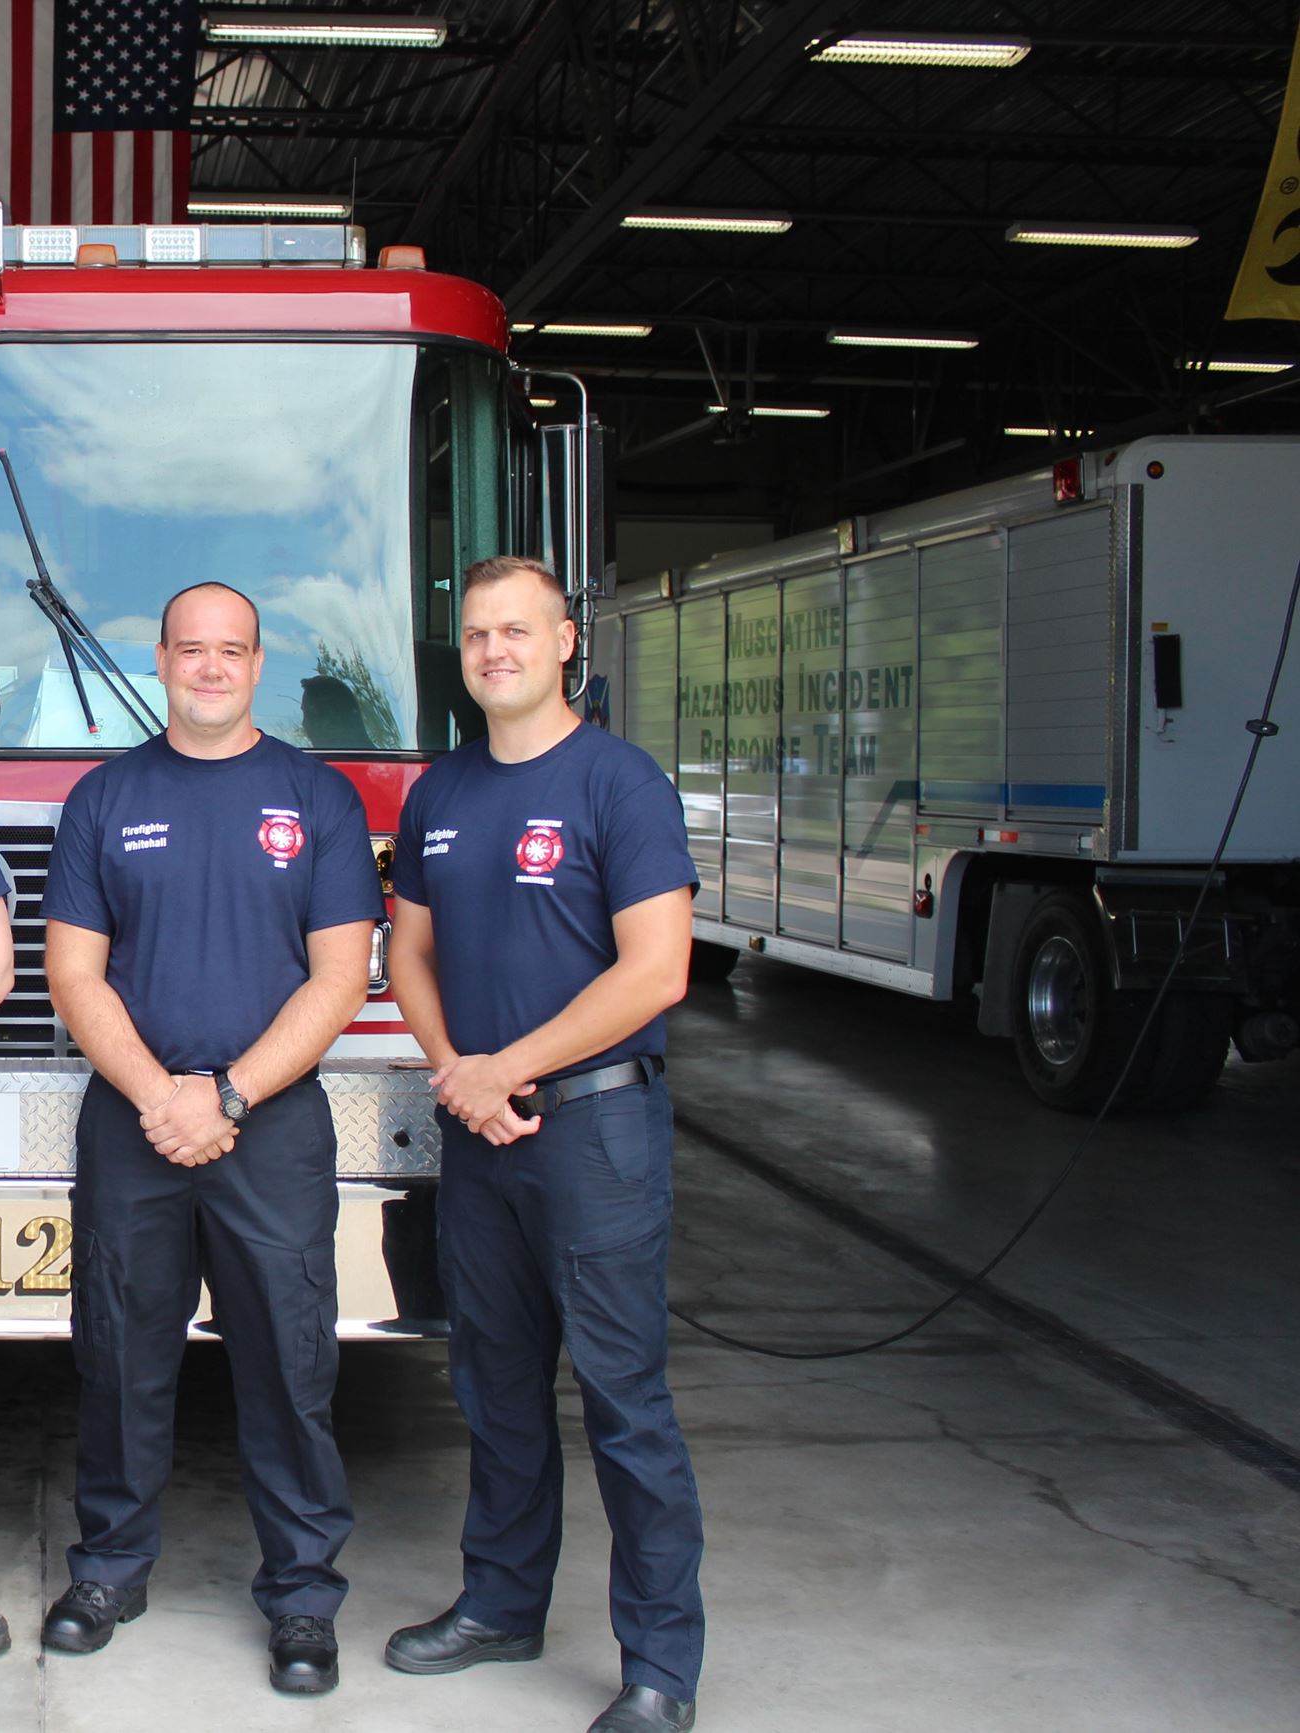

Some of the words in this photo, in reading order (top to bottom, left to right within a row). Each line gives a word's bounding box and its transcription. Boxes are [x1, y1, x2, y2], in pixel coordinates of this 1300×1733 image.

[727, 607, 840, 659] MUSCATINE
[678, 675, 784, 719] HAZARDOUS
[798, 663, 913, 713] INCIDENT
[701, 729, 800, 775] RESPONSE
[813, 724, 876, 776] TEAM
[122, 822, 169, 837] Firefighter
[124, 837, 167, 852] Whitehall
